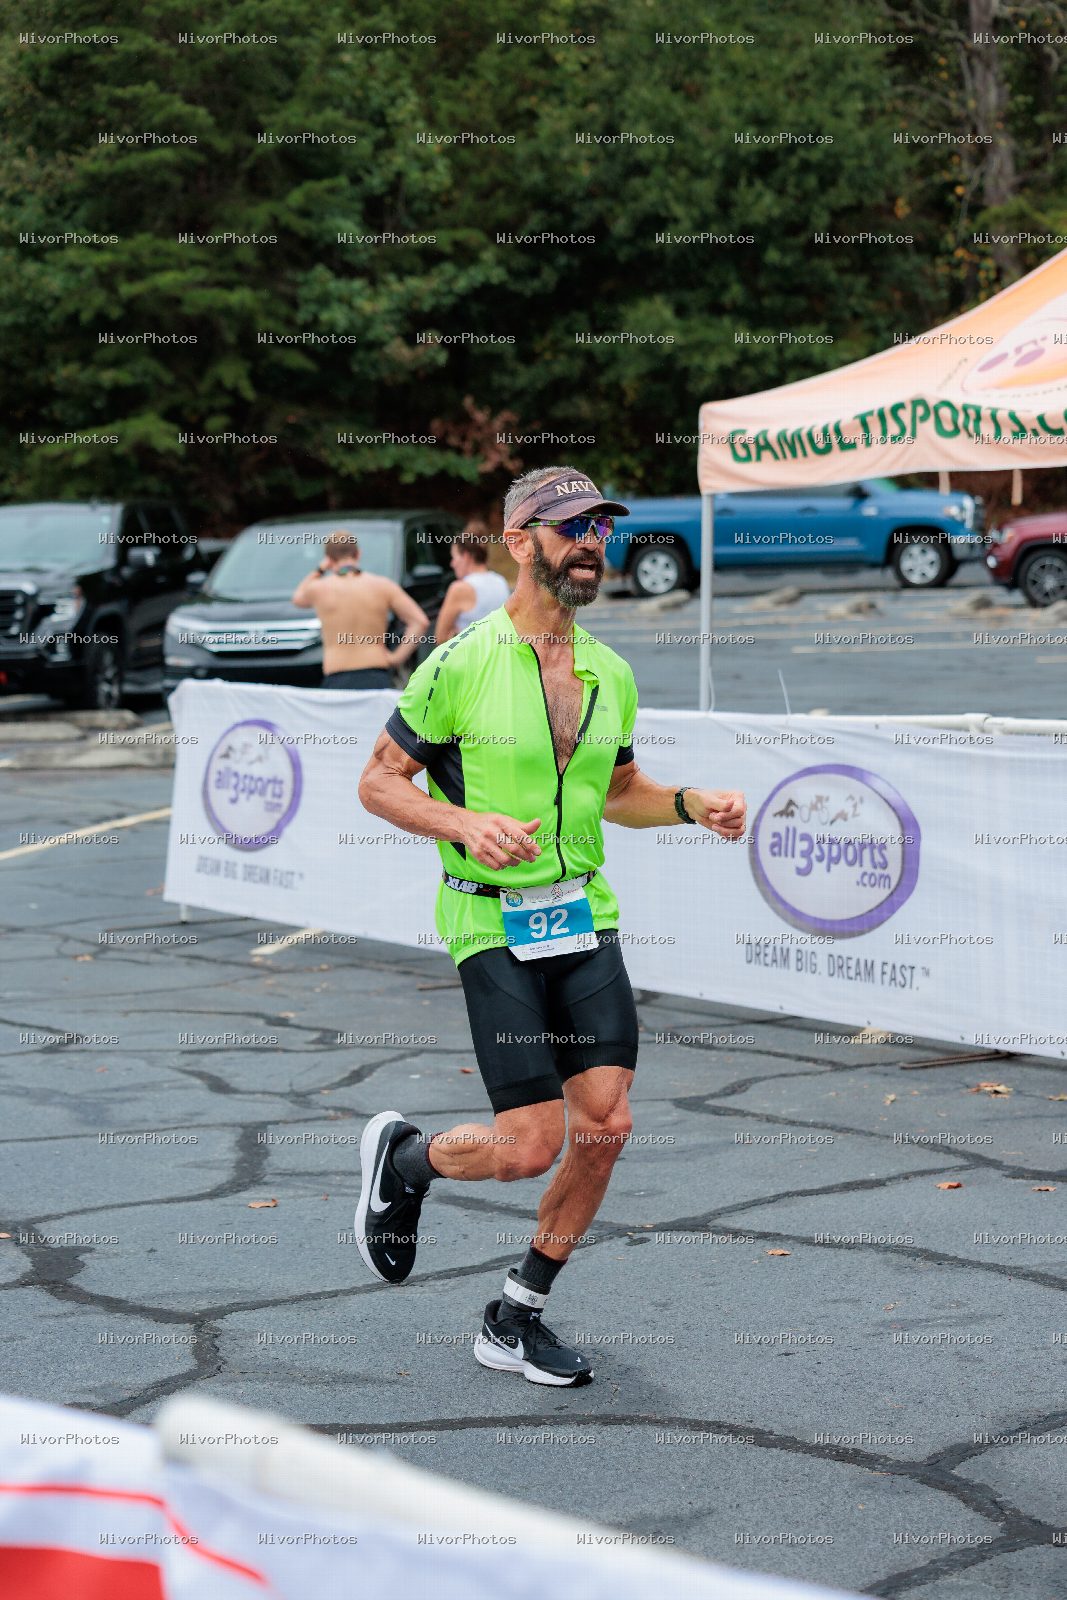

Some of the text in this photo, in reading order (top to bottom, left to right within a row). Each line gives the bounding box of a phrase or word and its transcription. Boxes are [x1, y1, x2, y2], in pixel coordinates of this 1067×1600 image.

[729, 398, 1067, 463] GAMULTISPORTS.C
[769, 826, 888, 876] all3sports
[856, 871, 892, 890] .com
[528, 908, 570, 939] 92
[745, 943, 791, 970] DREAM
[795, 949, 822, 975] BIG.
[827, 954, 875, 983] DREAM
